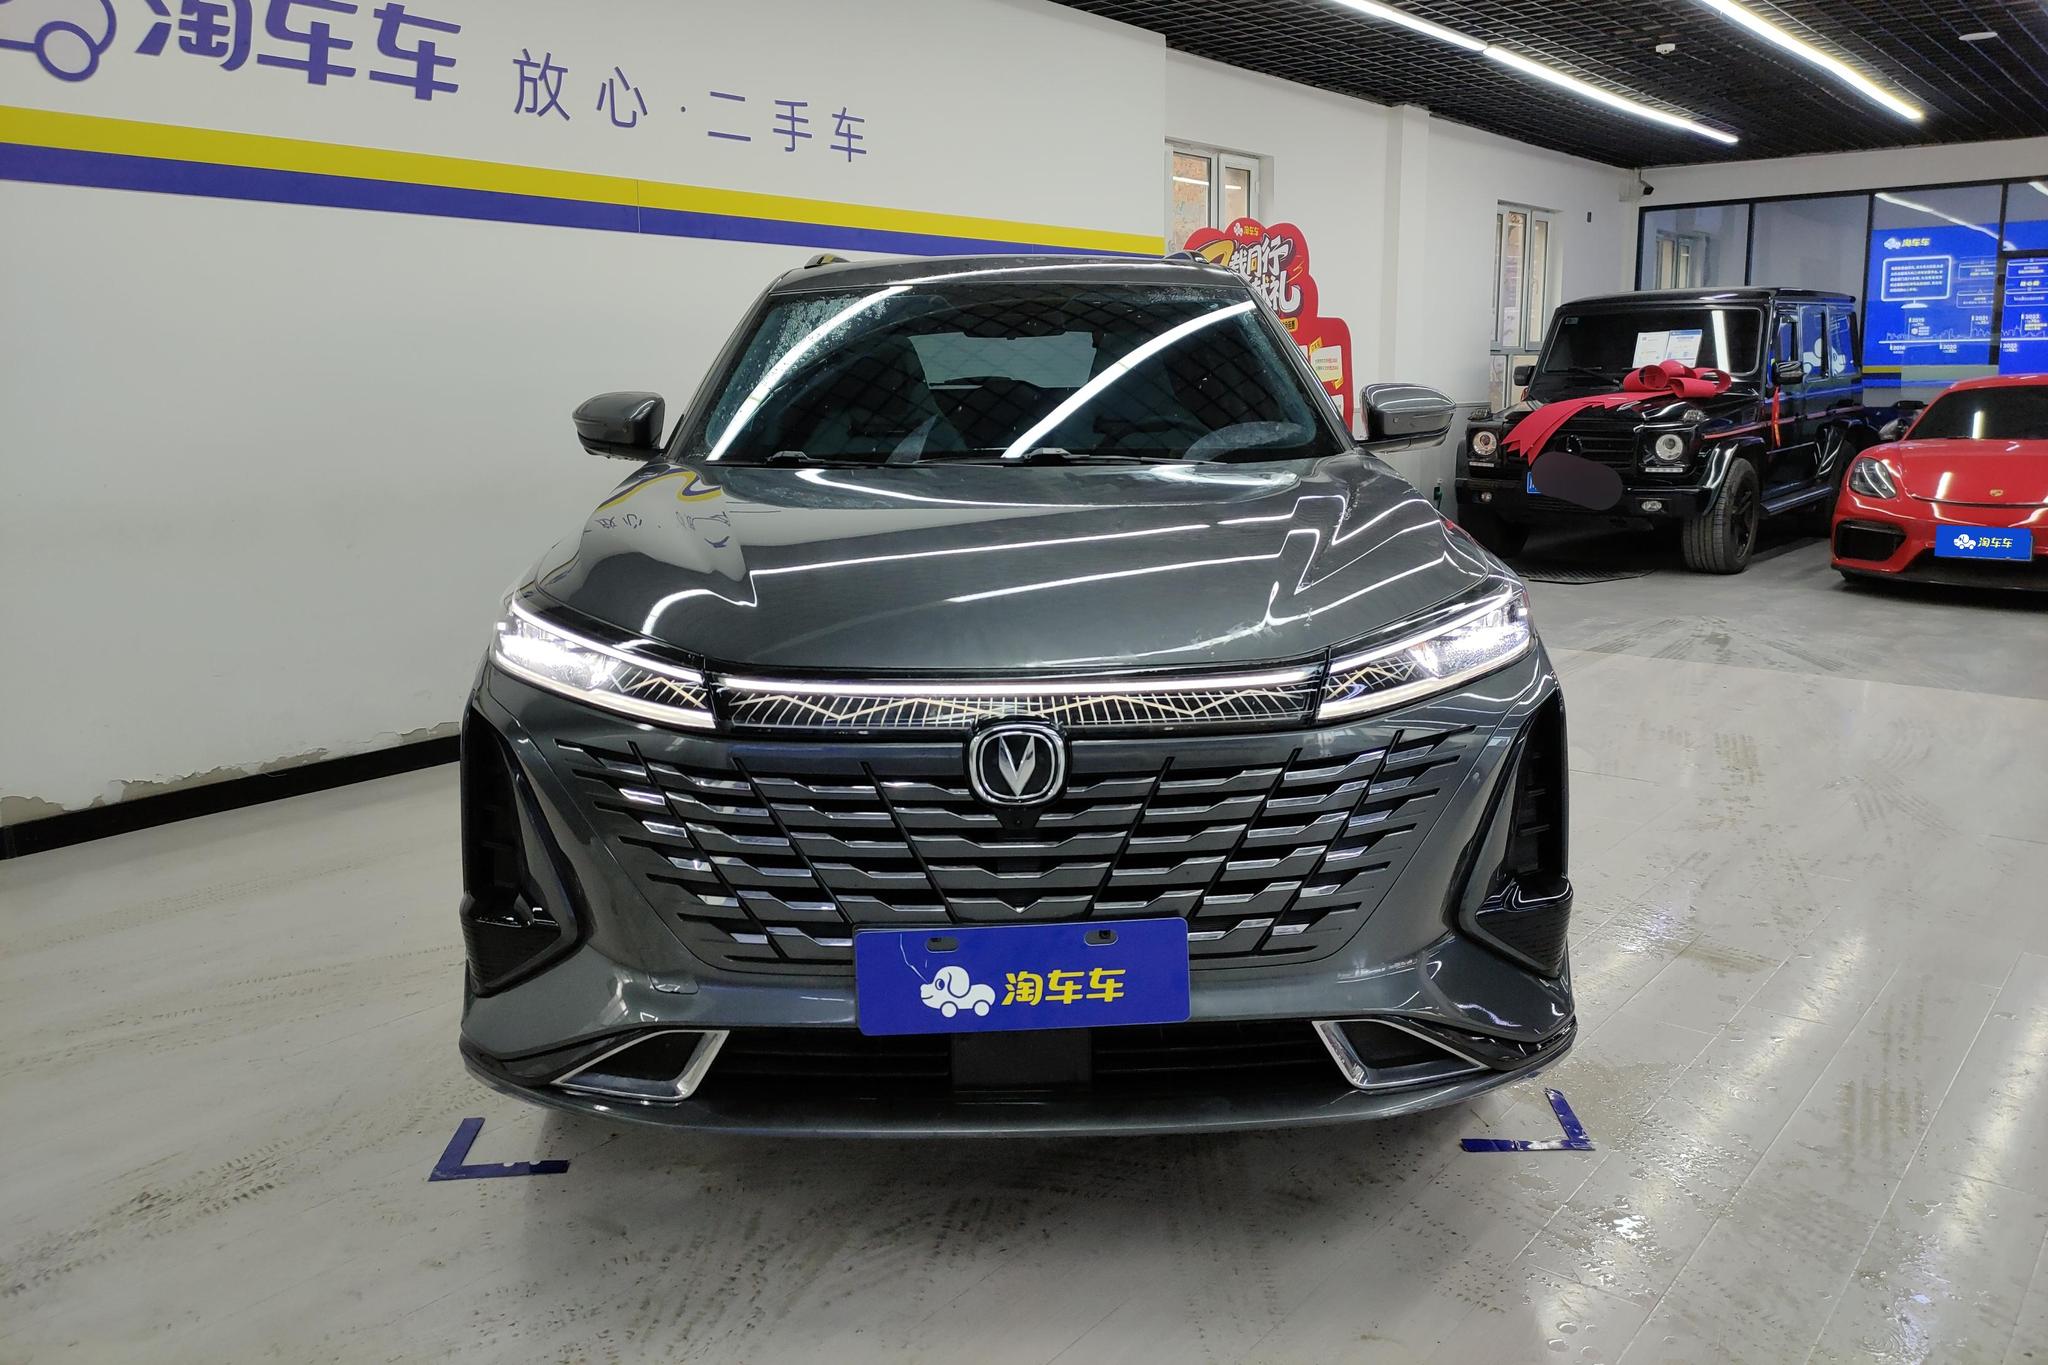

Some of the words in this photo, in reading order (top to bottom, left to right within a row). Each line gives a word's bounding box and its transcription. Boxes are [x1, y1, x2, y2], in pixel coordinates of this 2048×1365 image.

[134, 0, 462, 101] 淘车车
[1978, 537, 2014, 548] 淘车车
[1001, 967, 1126, 1006] 淘车车
